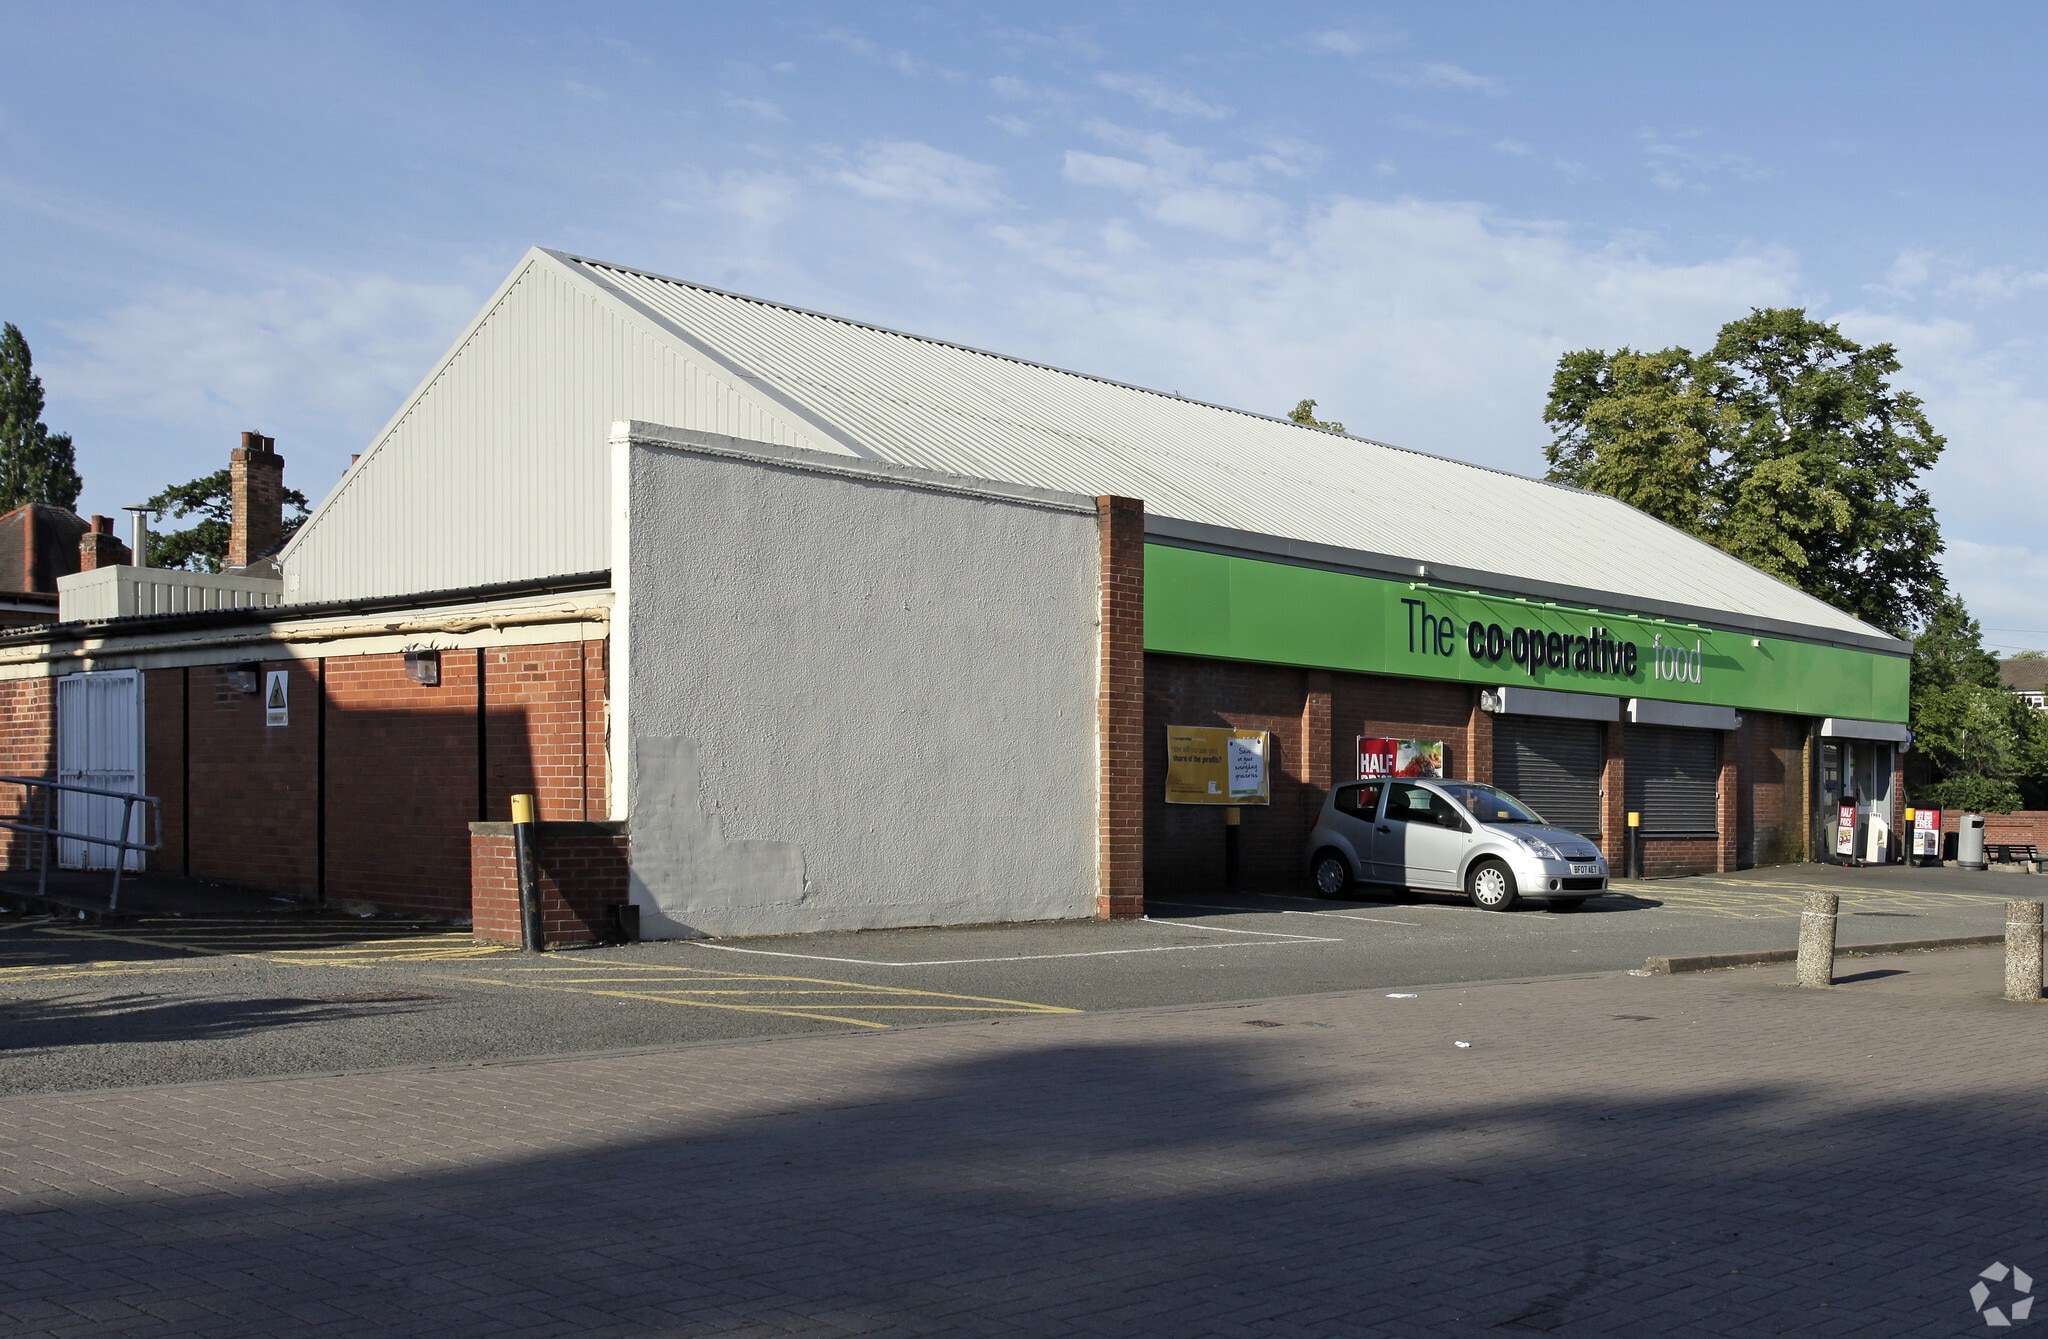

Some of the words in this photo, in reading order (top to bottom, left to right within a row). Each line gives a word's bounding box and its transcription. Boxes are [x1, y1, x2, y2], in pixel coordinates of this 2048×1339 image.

[1401, 597, 1455, 657] The
[1466, 620, 1638, 676] co-operative
[1653, 633, 1702, 684] food
[1202, 756, 1222, 764] profits?
[1243, 757, 1253, 765] your
[1360, 753, 1393, 773] HALF
[1235, 764, 1258, 773] everyday
[1840, 807, 1854, 817] HALF
[1839, 818, 1852, 827] PRICE
[1915, 819, 1933, 829] FREE
[1574, 865, 1587, 874] BF07
[1588, 865, 1597, 874] AET
